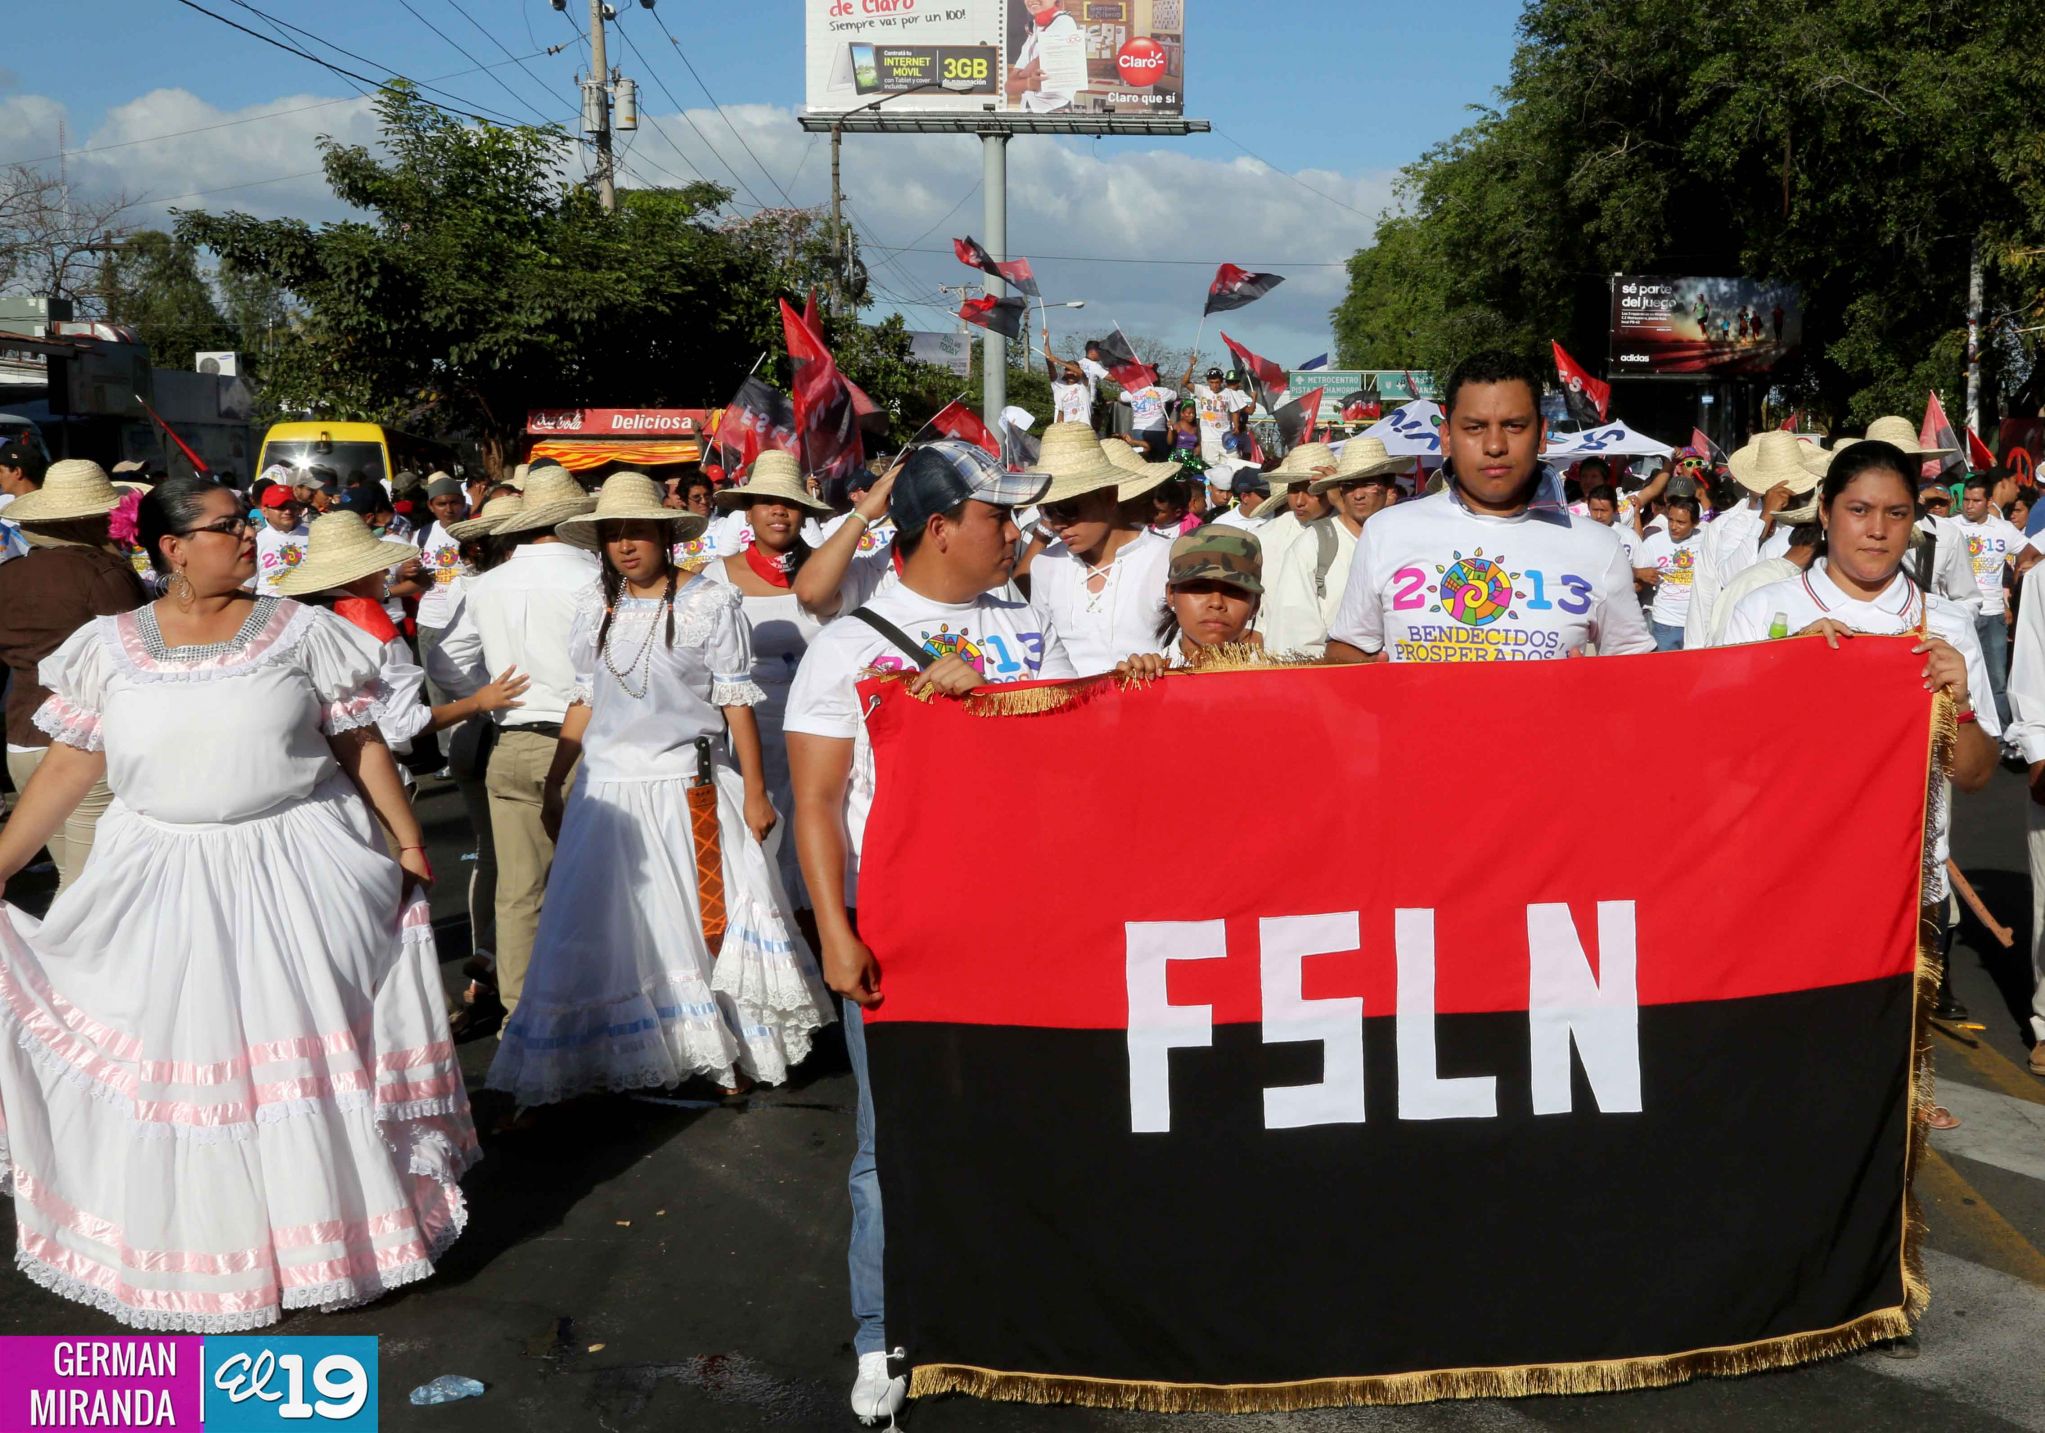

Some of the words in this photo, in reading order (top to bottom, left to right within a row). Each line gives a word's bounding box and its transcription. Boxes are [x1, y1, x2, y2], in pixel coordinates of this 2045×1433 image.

[829, 0, 853, 17] de
[829, 19, 876, 33] Siempre
[879, 18, 897, 27] vas
[901, 15, 919, 29] por
[925, 13, 942, 22] un
[945, 8, 967, 21] 100!
[883, 57, 932, 67] INTERNET
[1118, 53, 1160, 68] Claro
[892, 65, 922, 77] MÓVIL
[943, 58, 988, 79] 3GB
[1107, 92, 1139, 104] Claro
[1141, 94, 1163, 107] que
[1165, 91, 1176, 104] sí
[1621, 282, 1638, 294] sé
[1639, 283, 1673, 297] parte
[1621, 296, 1641, 308] del
[1641, 296, 1677, 310] juego
[1620, 354, 1650, 363] adidas
[1307, 376, 1359, 384] METROCENTRO
[611, 414, 692, 430] Deliciosa
[1407, 625, 1565, 651] BENDECIDOS,
[1125, 900, 1642, 1133] FSLN
